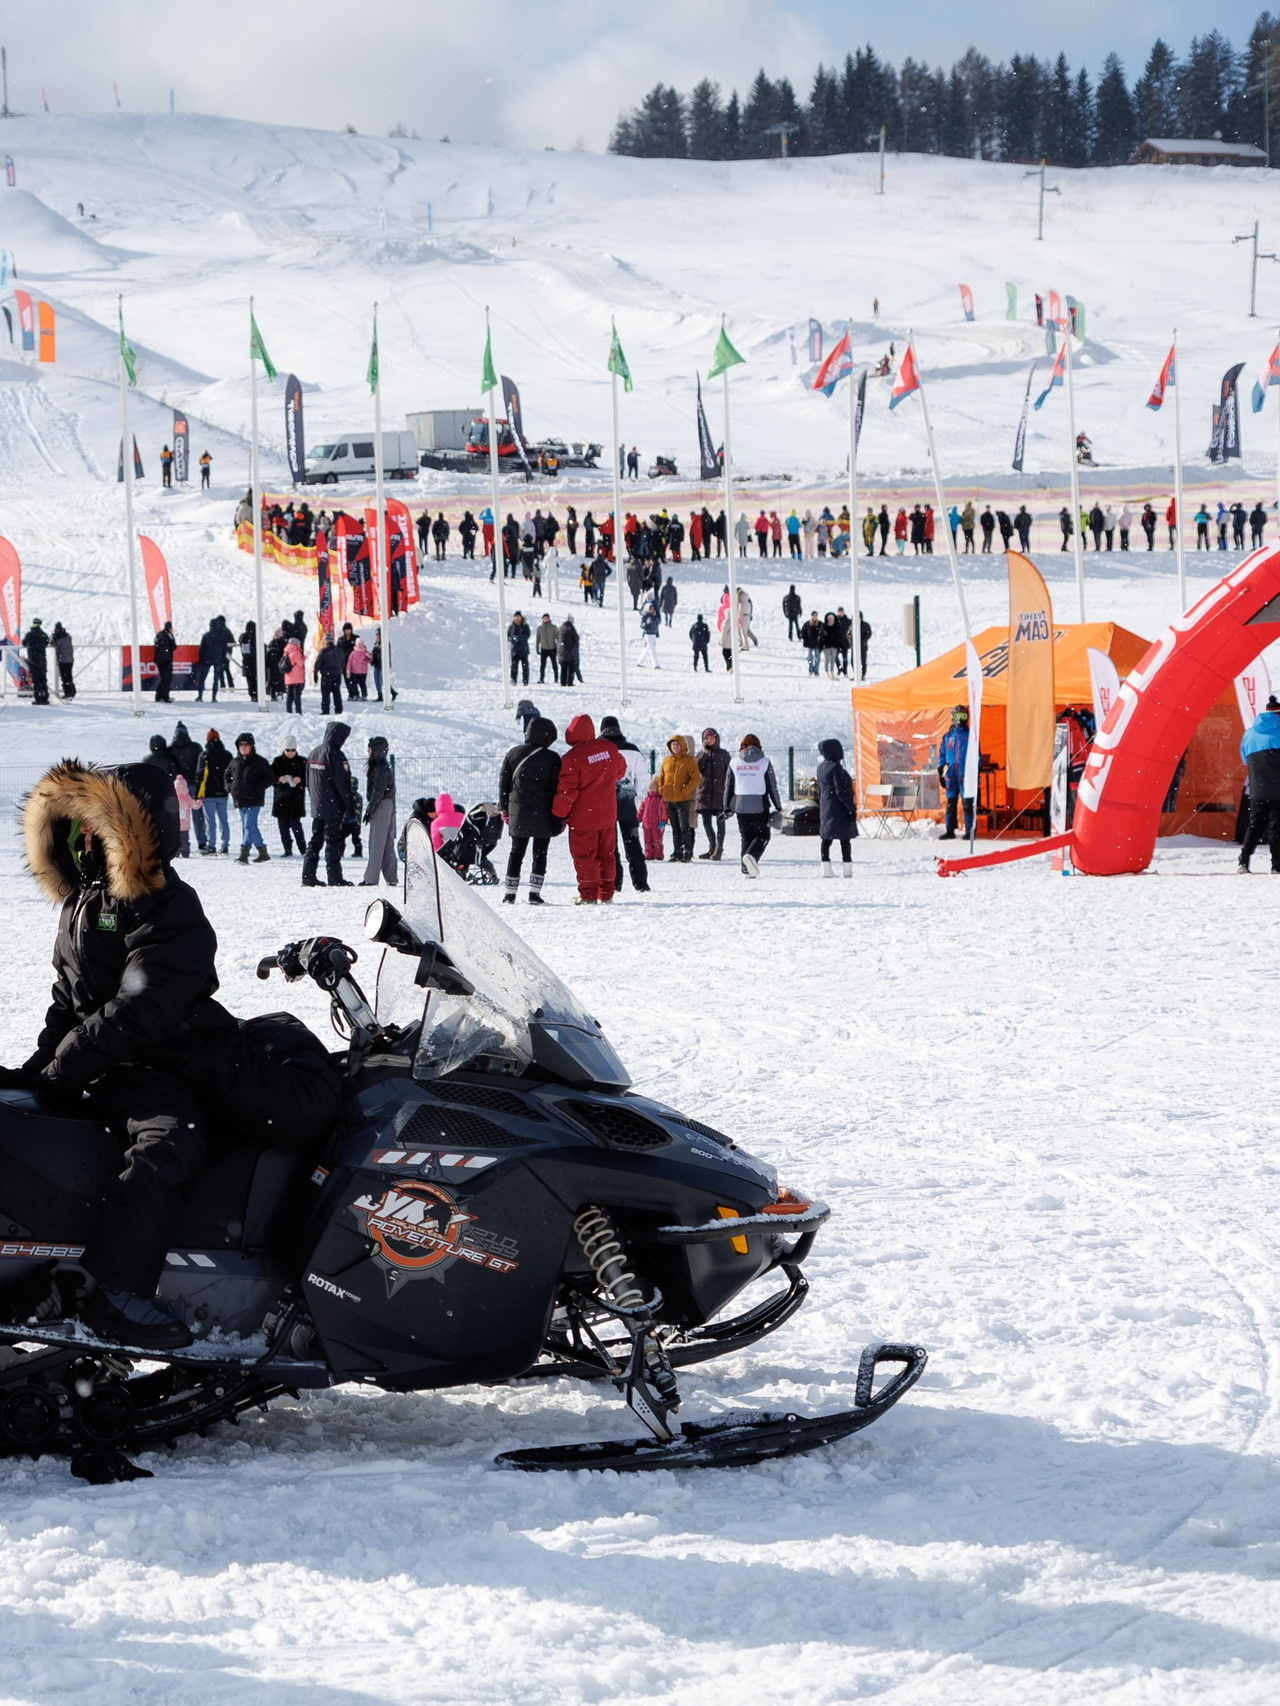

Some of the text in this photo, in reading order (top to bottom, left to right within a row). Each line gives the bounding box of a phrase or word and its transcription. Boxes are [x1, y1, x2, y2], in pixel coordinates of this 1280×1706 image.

[587, 749, 610, 765] RUSSIA
[690, 1146, 713, 1159] 900
[367, 1217, 487, 1264] ADVENTURE
[488, 1256, 517, 1271] GT
[307, 1272, 347, 1299] ROTAX
